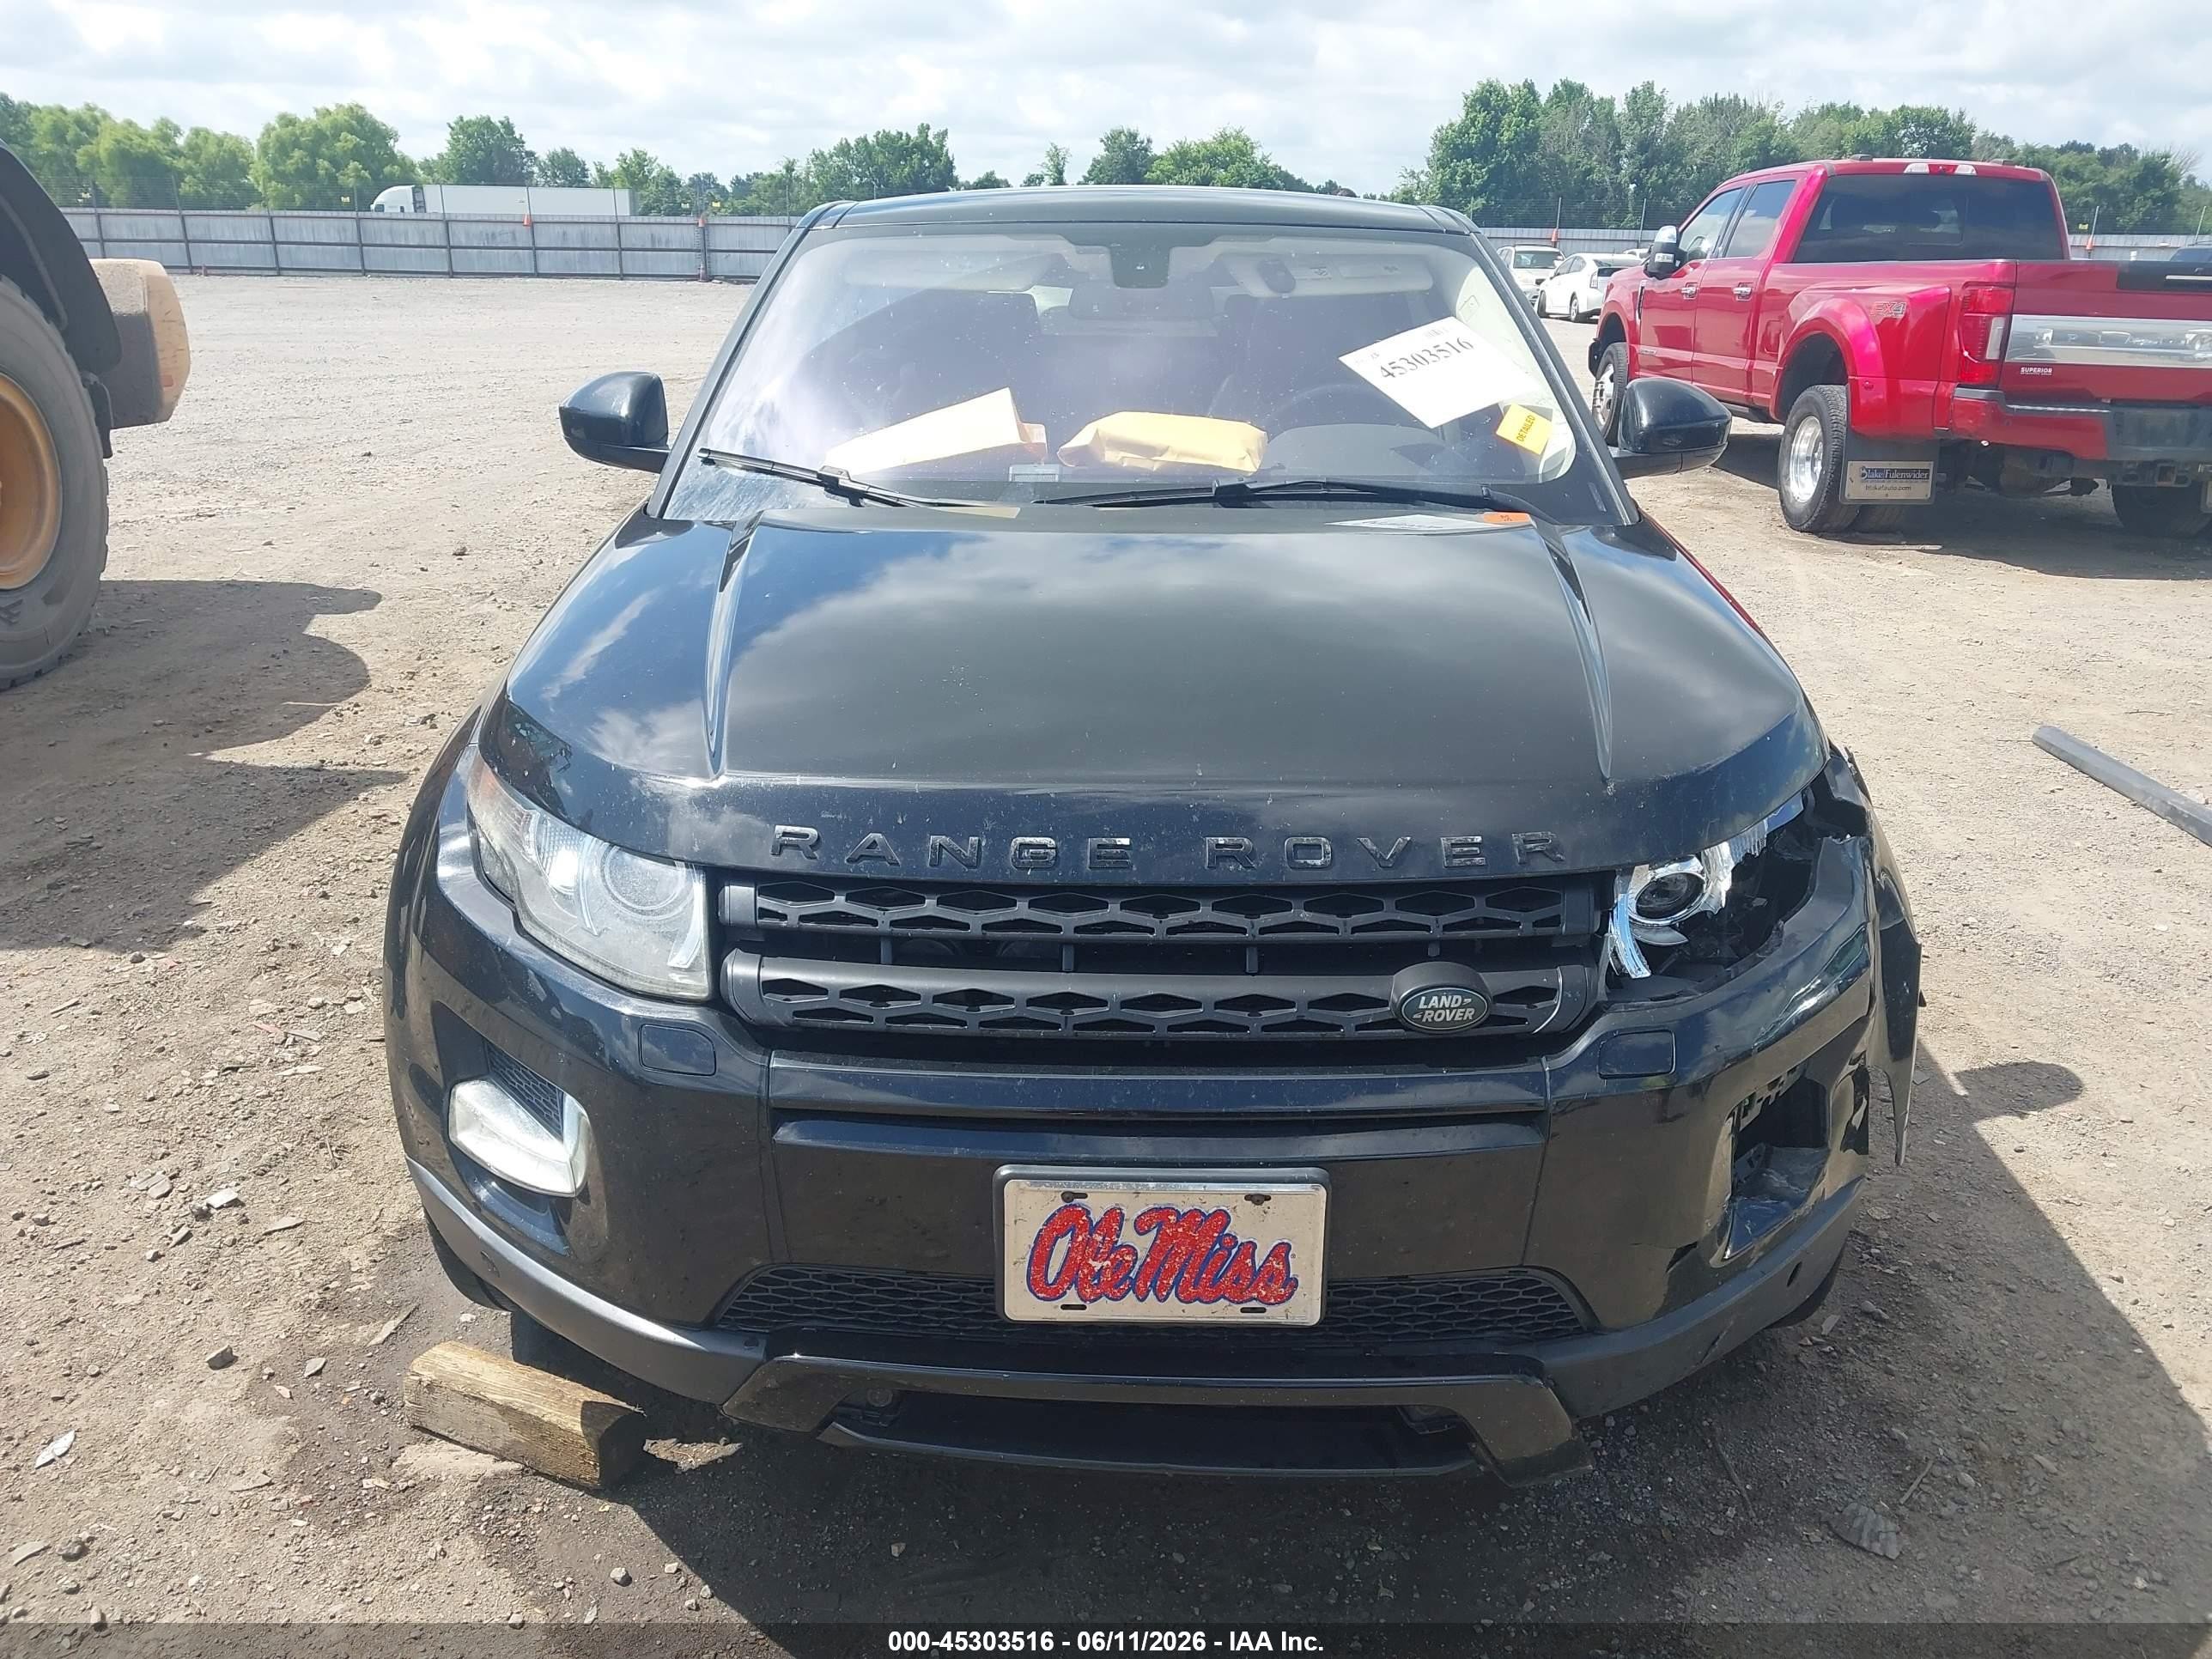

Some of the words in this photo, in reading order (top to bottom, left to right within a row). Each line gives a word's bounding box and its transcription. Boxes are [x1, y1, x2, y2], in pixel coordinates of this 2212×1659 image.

[1869, 301, 1906, 317] FX4
[1380, 337, 1474, 378] 45303516
[1516, 415, 1536, 442] DETAILED
[1860, 466, 1884, 479] Blake
[1885, 468, 1929, 479] Fulenwider
[771, 825, 1133, 871] RANGE
[1205, 831, 1565, 869] ROVER
[1418, 995, 1462, 1009] LAND
[1422, 1008, 1475, 1023] ROVER
[1028, 1204, 1138, 1304] Ole
[1133, 1206, 1298, 1305] Miss
